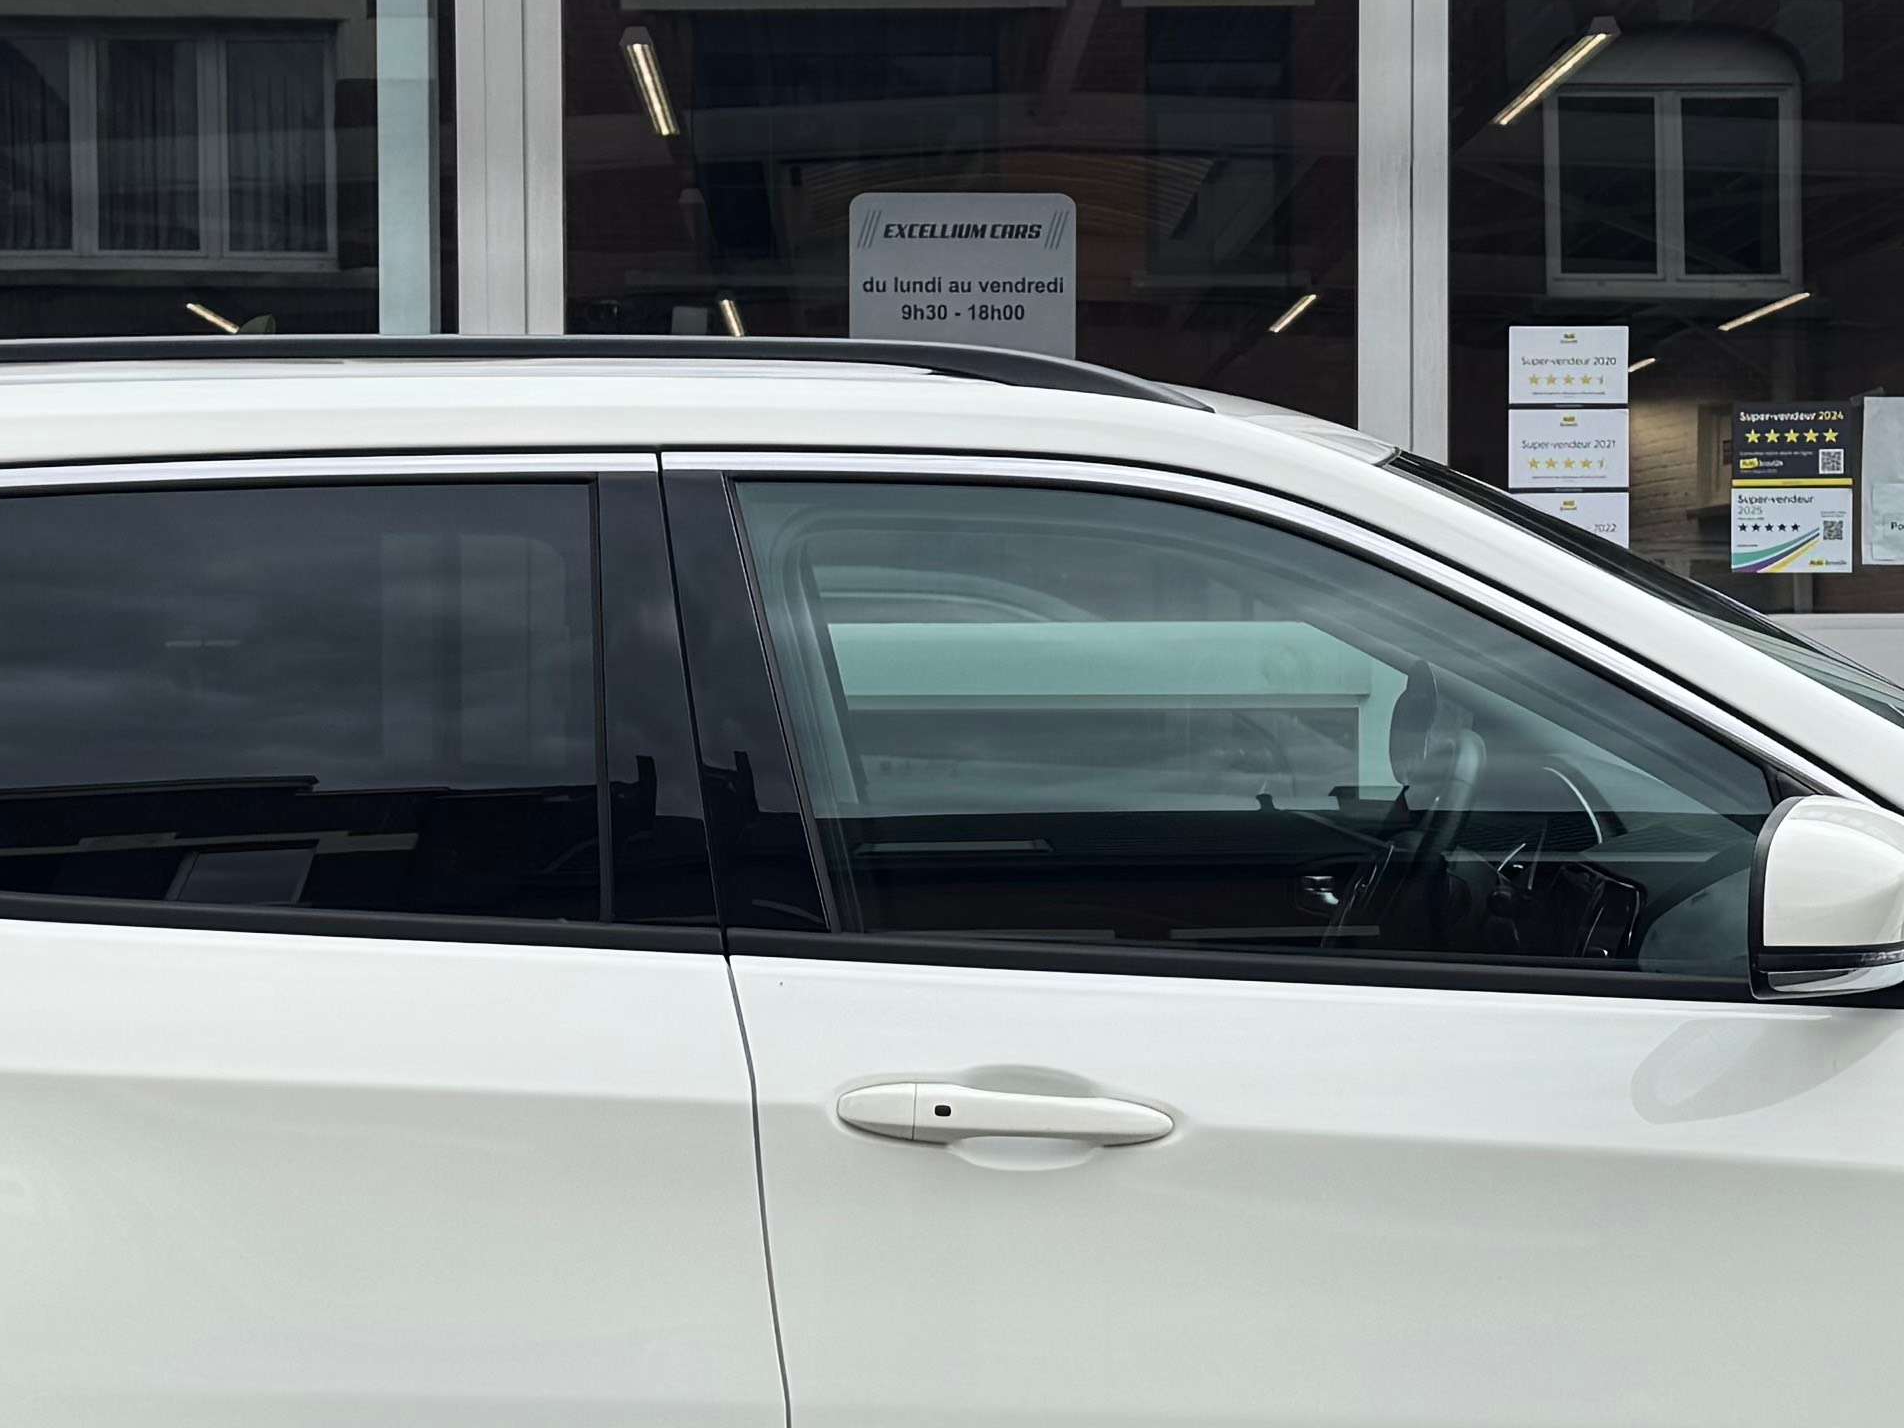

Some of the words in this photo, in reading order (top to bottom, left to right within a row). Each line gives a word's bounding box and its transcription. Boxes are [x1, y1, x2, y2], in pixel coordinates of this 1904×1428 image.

[882, 223, 986, 241] EXCELLIUM
[989, 223, 1043, 241] CARS
[862, 276, 887, 294] du
[893, 276, 942, 294] lundi
[948, 279, 972, 294] au
[978, 277, 1065, 294] vendredi
[901, 304, 948, 321] 9h30
[967, 304, 1026, 321] 18h00
